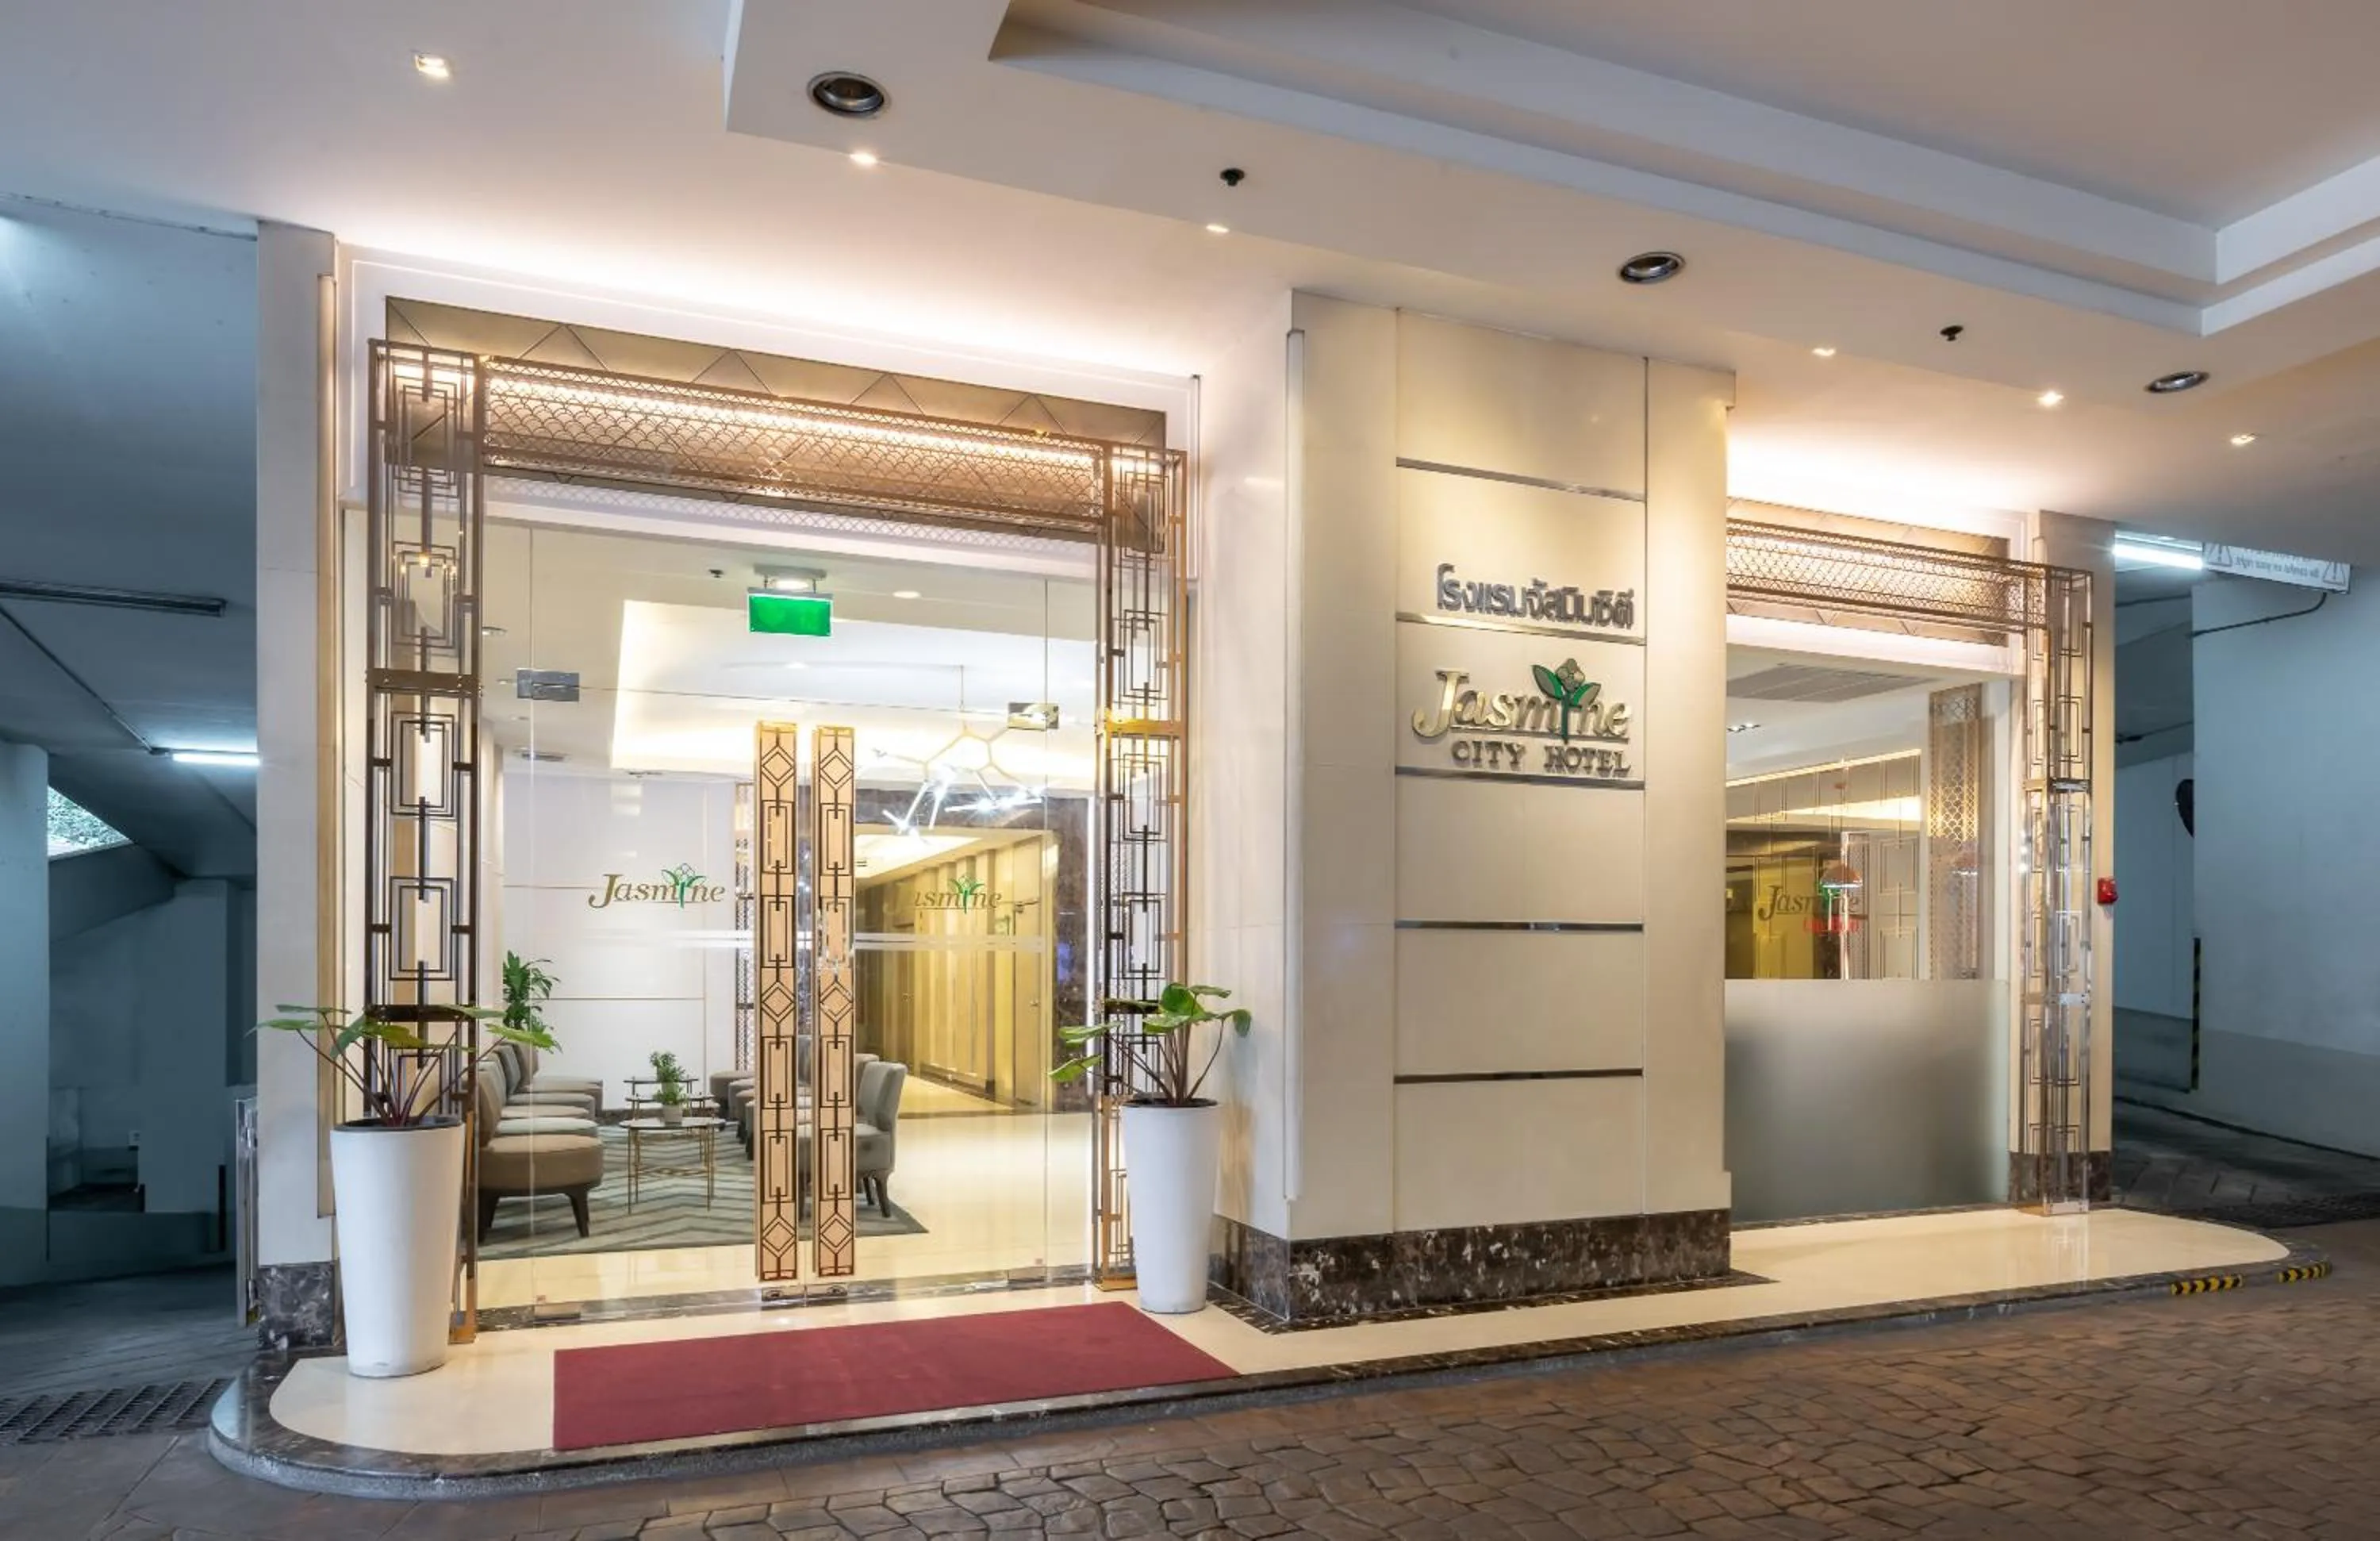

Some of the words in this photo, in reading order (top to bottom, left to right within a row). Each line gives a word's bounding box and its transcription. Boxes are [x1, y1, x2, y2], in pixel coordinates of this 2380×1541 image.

[1411, 663, 1631, 743] Jasmine
[1451, 740, 1526, 769] CITY
[1543, 744, 1631, 775] HOTEL
[588, 867, 726, 909] Jasmine
